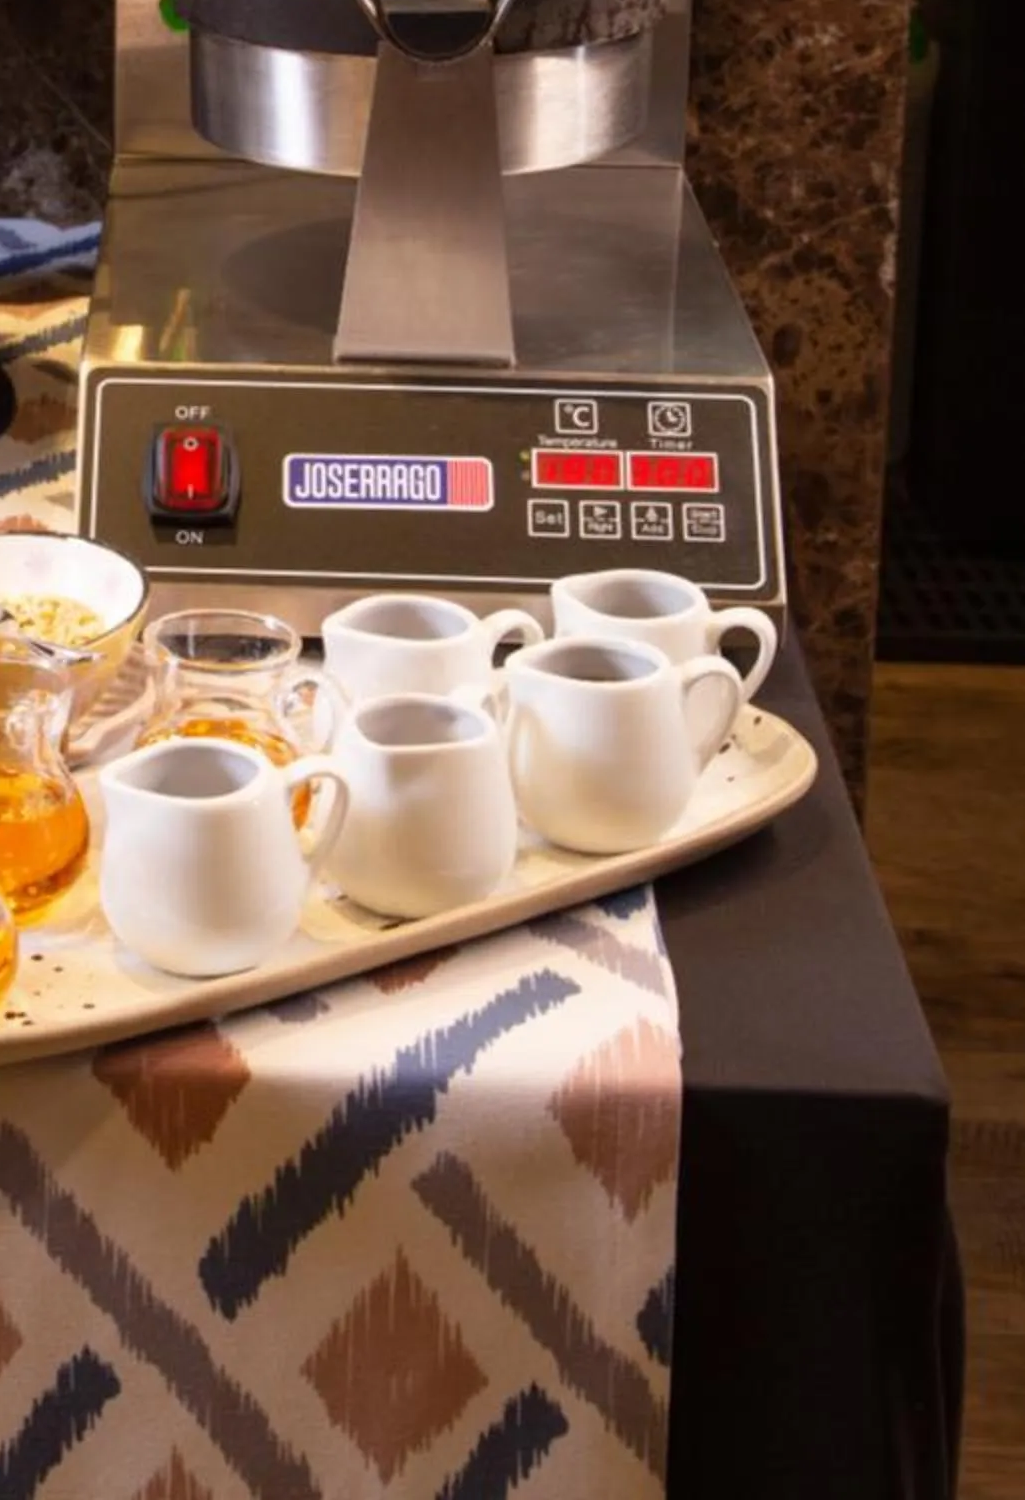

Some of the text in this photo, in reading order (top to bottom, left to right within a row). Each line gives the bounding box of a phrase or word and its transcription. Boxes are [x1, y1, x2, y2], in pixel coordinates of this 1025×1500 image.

[175, 405, 211, 420] OFF
[537, 434, 618, 451] Temperature
[649, 437, 694, 451] Timer
[535, 510, 563, 526] Set
[175, 529, 205, 545] ON
